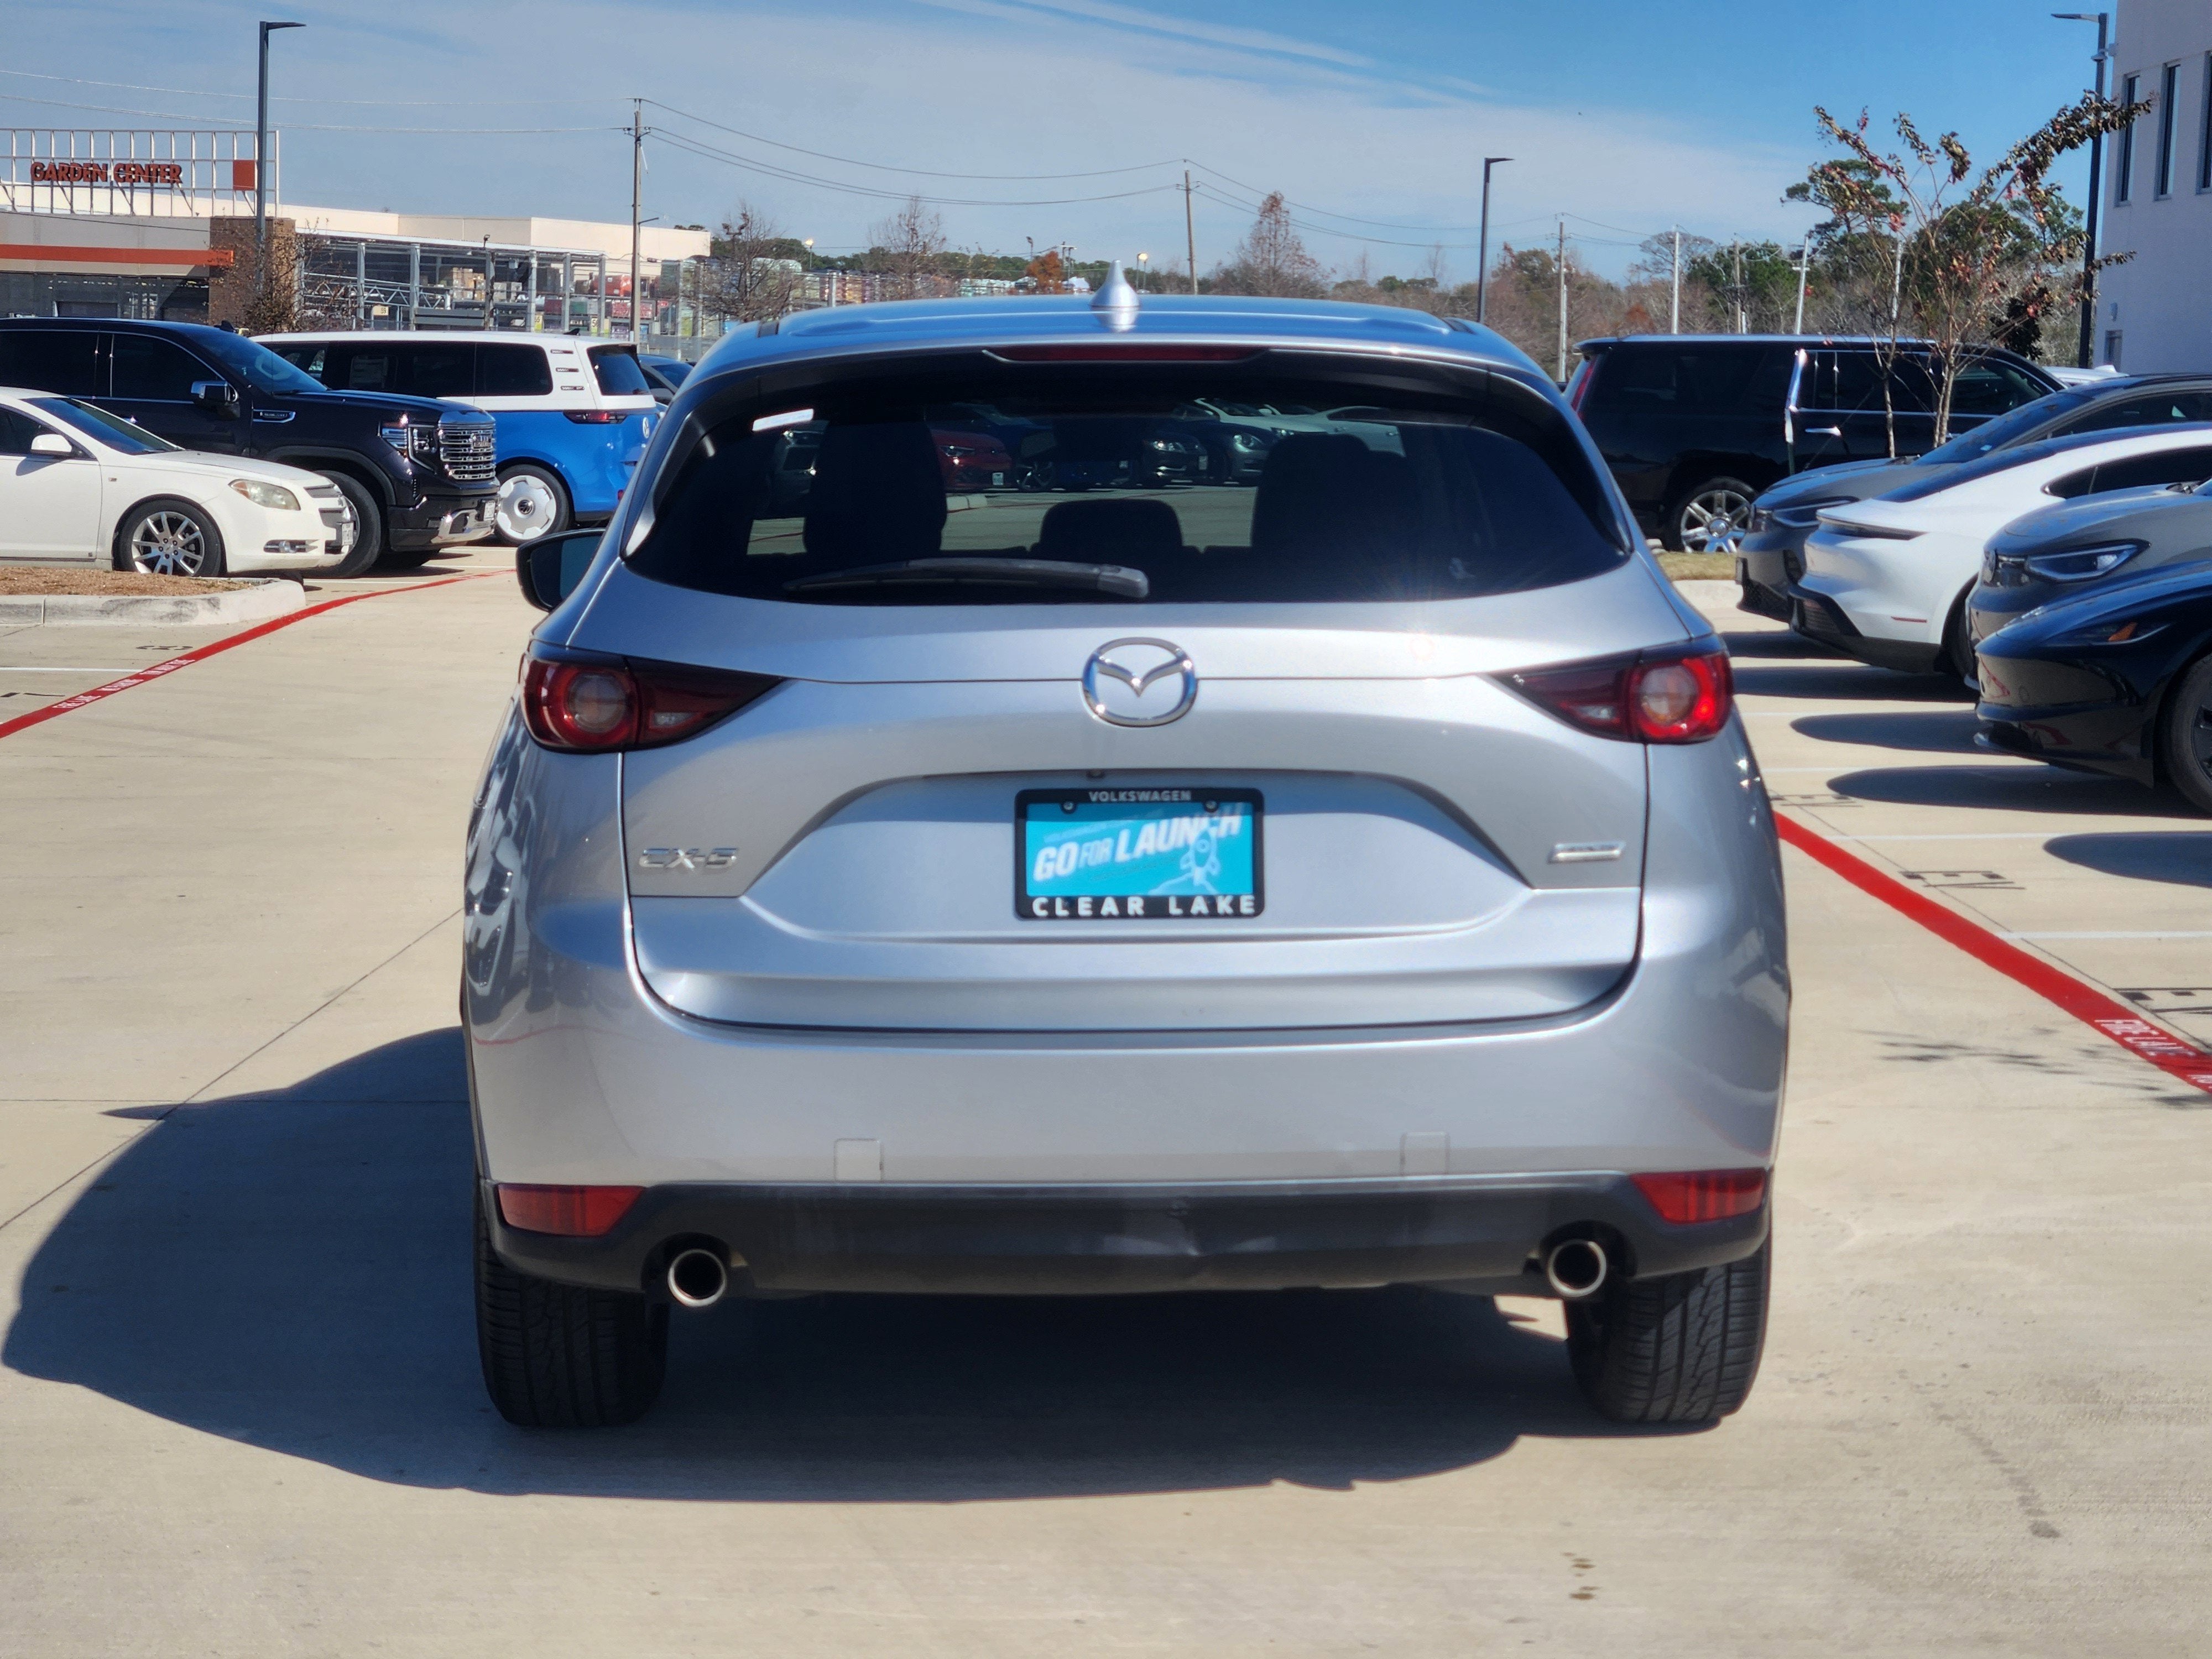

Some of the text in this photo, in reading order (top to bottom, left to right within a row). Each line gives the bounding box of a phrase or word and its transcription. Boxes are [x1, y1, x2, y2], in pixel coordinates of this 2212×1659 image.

[30, 162, 183, 184] GARDEN CENTER
[1089, 791, 1191, 801] VOLKSWAGEN
[639, 848, 738, 869] CX-5
[1034, 843, 1079, 881] GO
[1032, 895, 1255, 916] CLEAR LAKE
